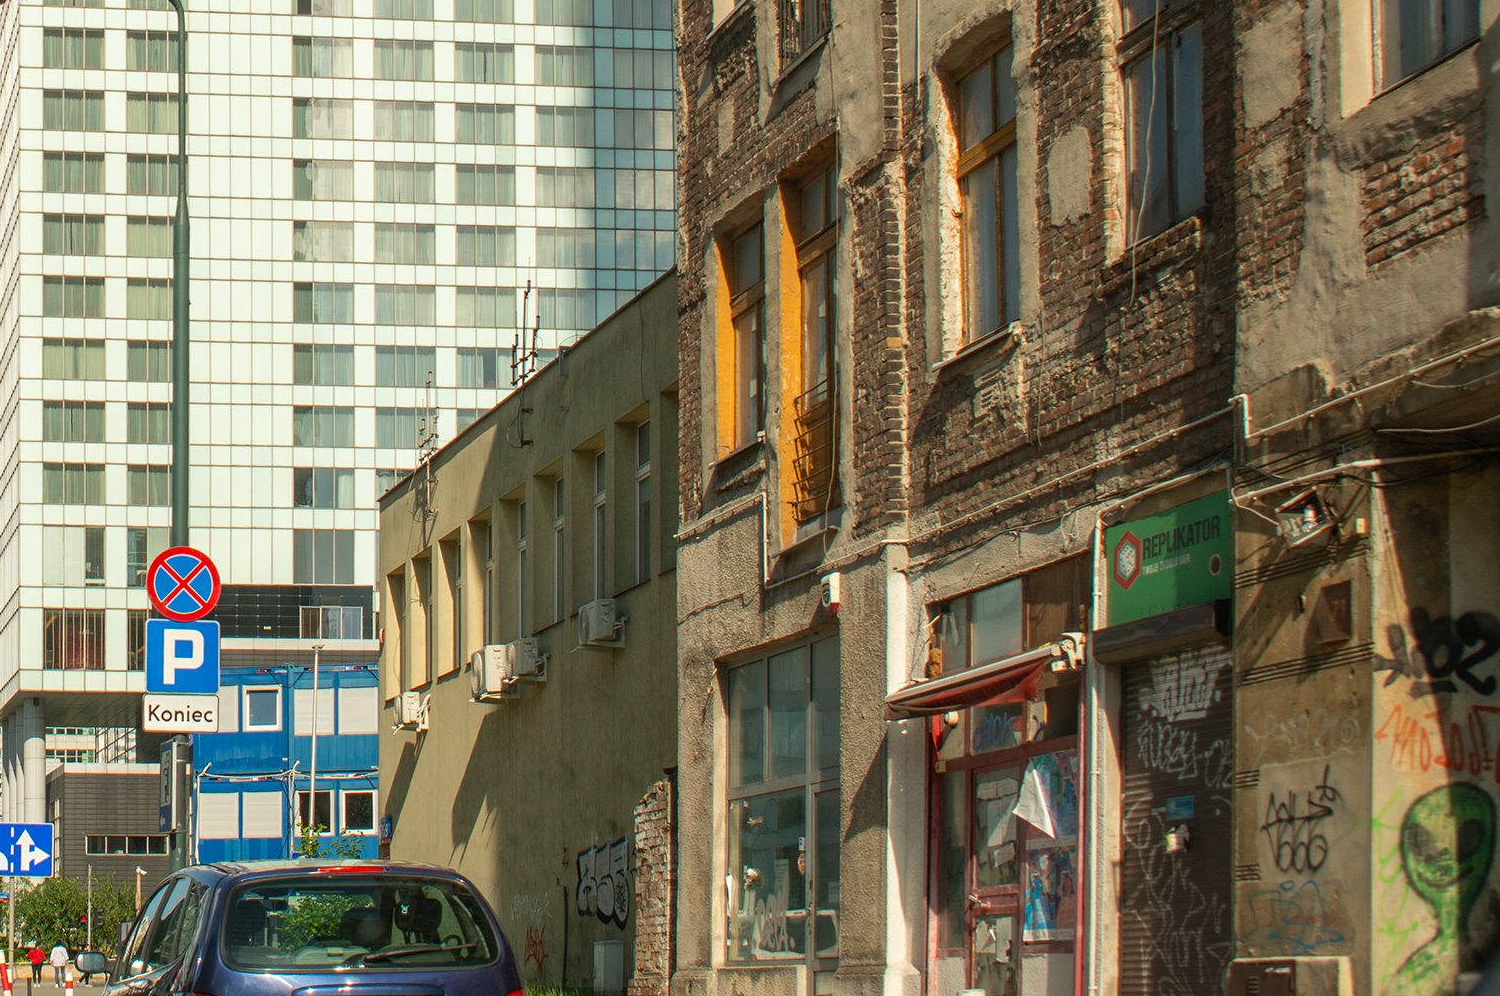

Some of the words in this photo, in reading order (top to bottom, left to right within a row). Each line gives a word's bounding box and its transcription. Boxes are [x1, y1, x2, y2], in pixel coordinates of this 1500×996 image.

[1142, 515, 1220, 560] REPLIKATOR
[163, 629, 205, 685] P
[148, 704, 214, 723] Koniec
